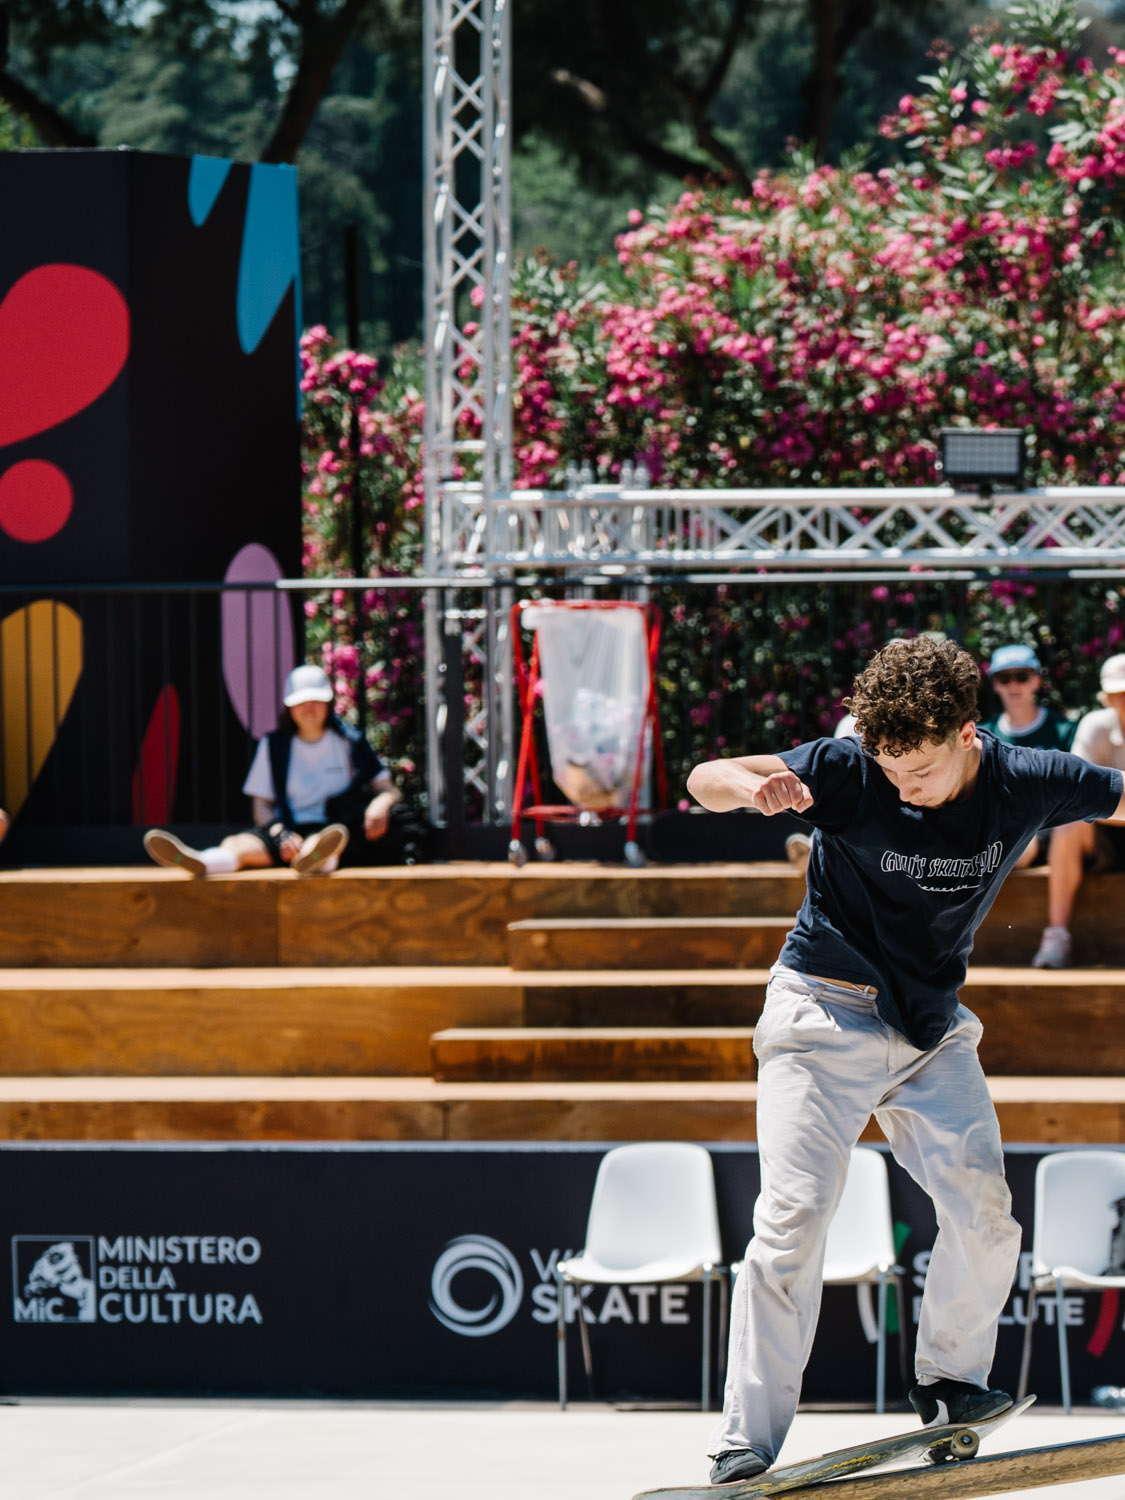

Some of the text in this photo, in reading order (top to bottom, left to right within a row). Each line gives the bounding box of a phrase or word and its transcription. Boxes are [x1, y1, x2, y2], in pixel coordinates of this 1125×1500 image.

[98, 1236, 262, 1264] MINISTERO
[99, 1266, 177, 1290] DELLA
[100, 1292, 263, 1325] CULTURA
[531, 1284, 690, 1324] SKATE
